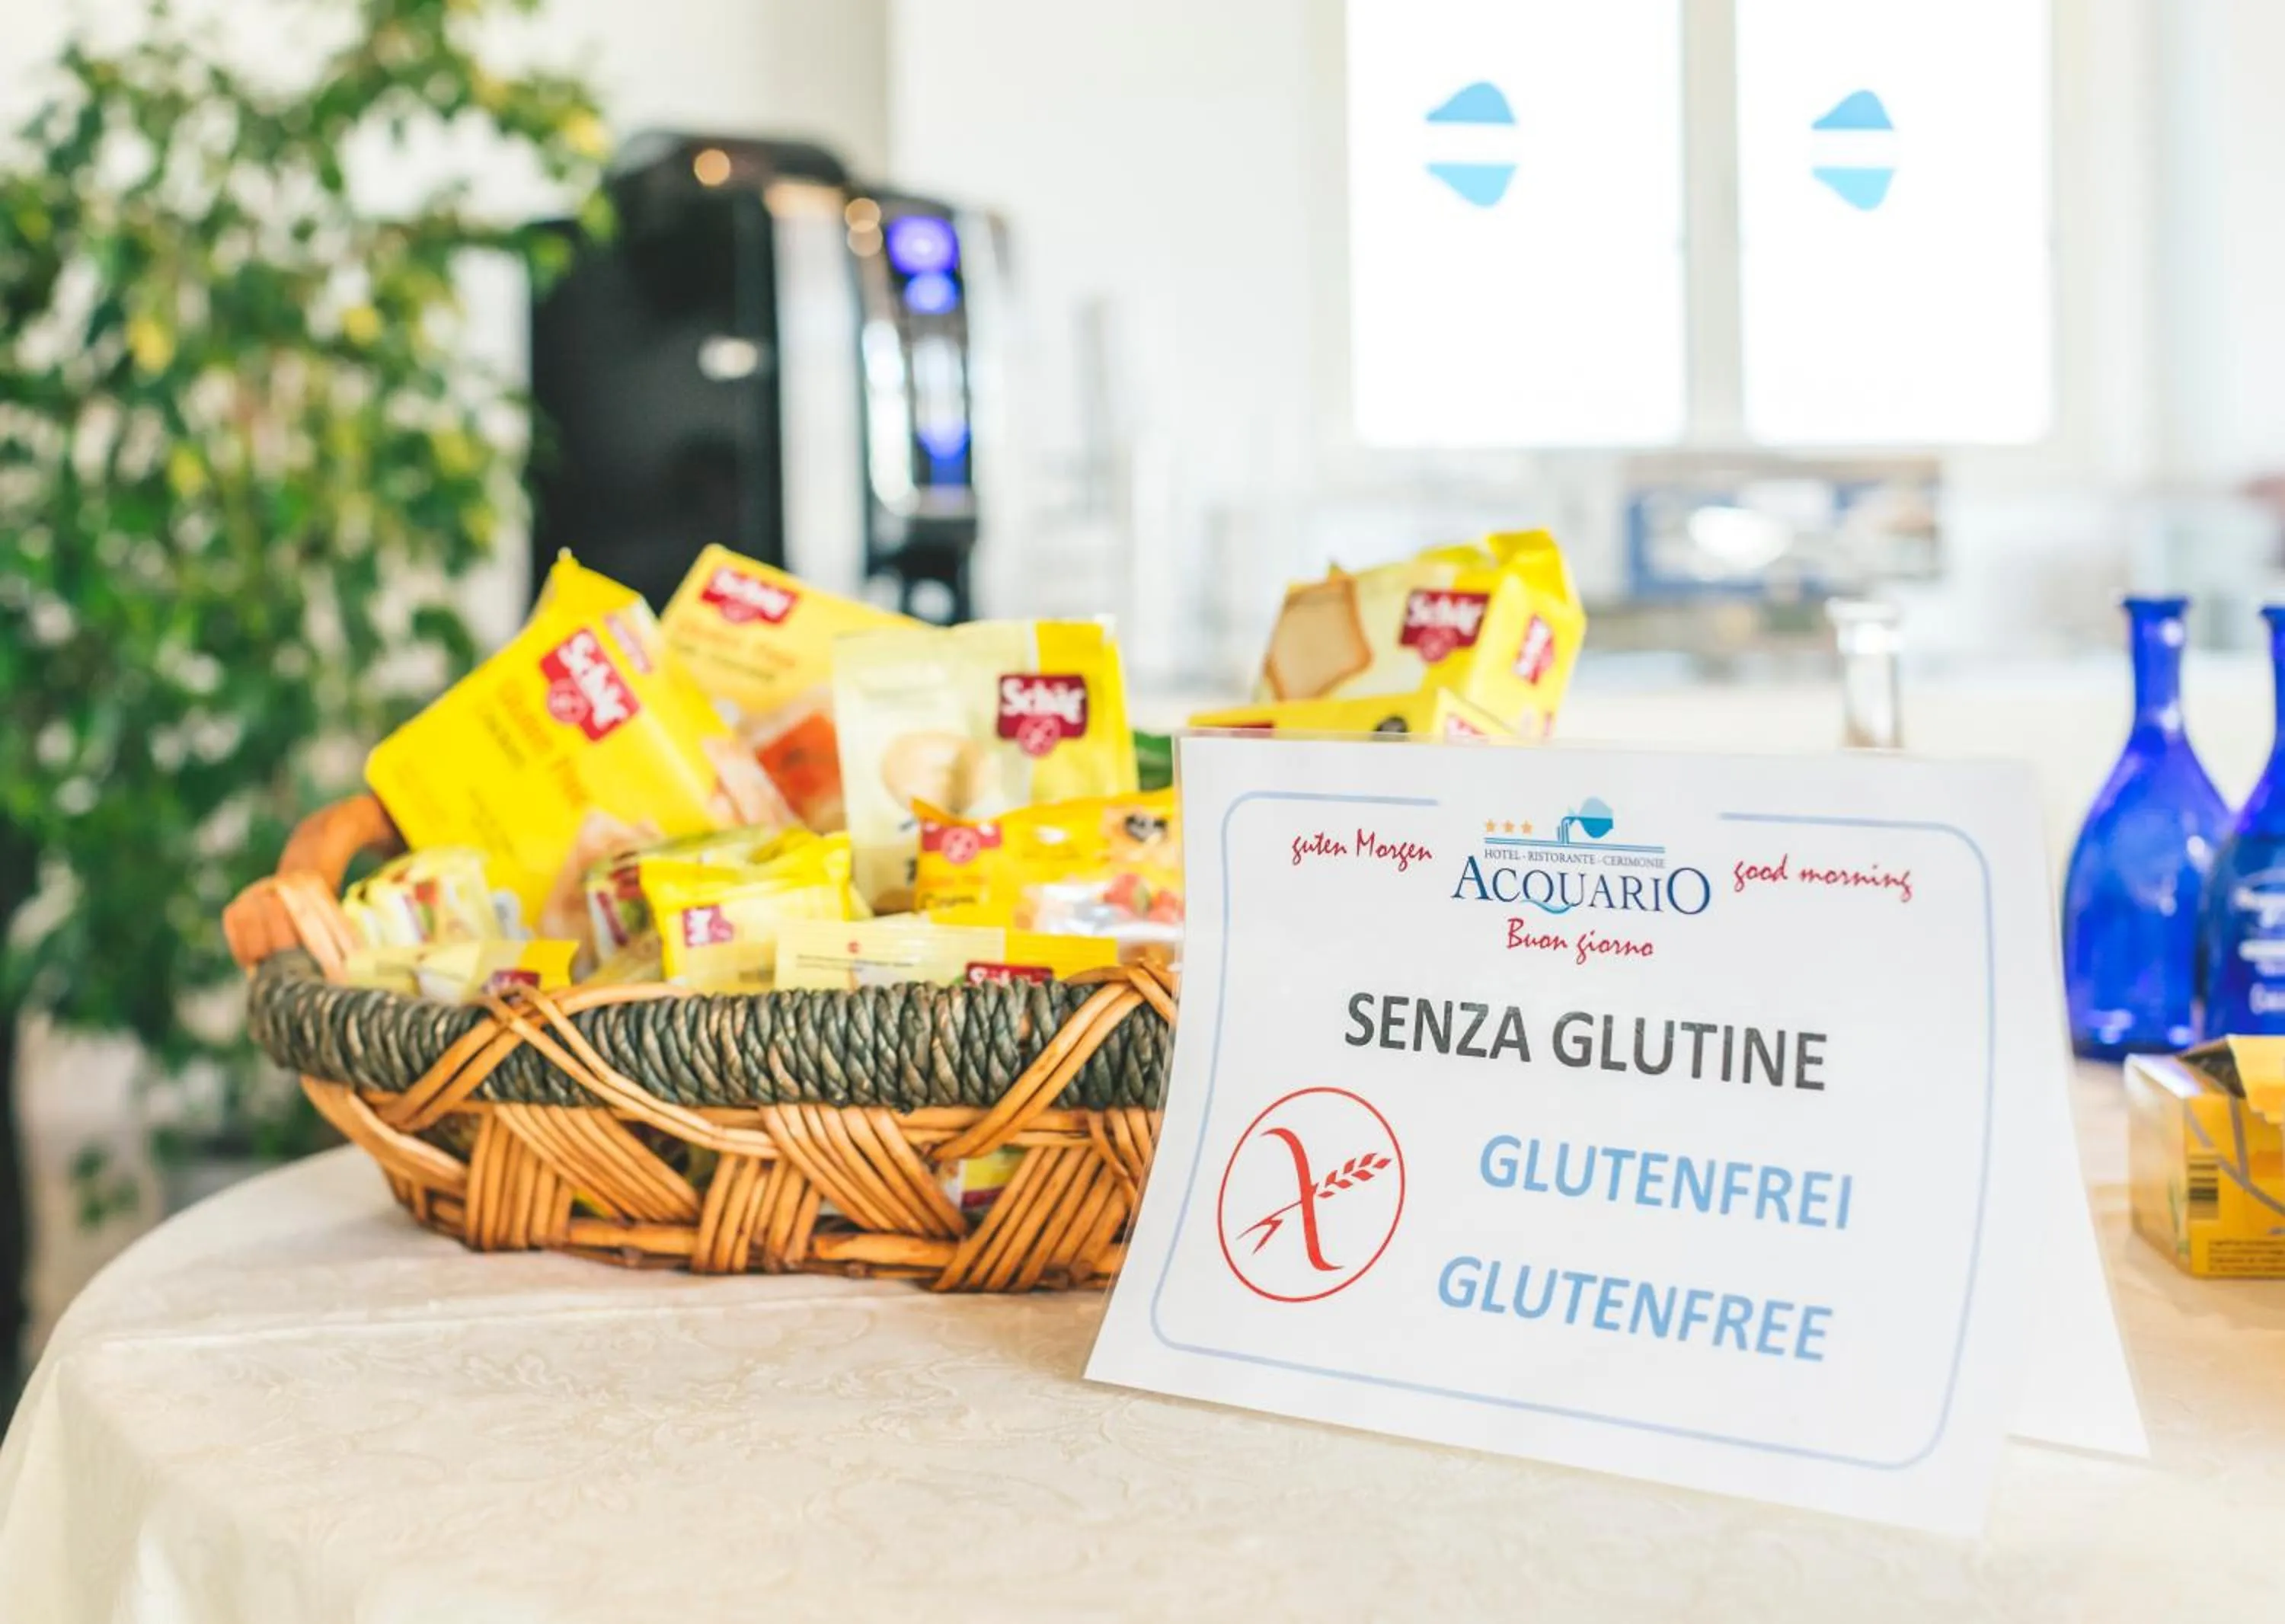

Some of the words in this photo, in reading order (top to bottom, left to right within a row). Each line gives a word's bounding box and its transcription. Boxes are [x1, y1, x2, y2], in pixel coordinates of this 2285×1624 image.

[1292, 832, 1347, 866] guten
[1357, 829, 1433, 872] Morgen
[1484, 849, 1521, 861] HOTEL
[1527, 851, 1596, 865] RISTORANTE
[1602, 855, 1666, 868] CERIMONIE
[1734, 853, 1788, 893] good
[1798, 865, 1913, 903] morning
[1450, 855, 1711, 915] ACQUARIO
[1507, 917, 1568, 951] Buon
[1576, 929, 1654, 965] giorno
[1345, 993, 1531, 1063] SENZA
[1552, 1012, 1827, 1091] GLUTINE
[1480, 1135, 1852, 1229] GLUTENFREI
[1438, 1257, 1833, 1361] GLUTENFREE
